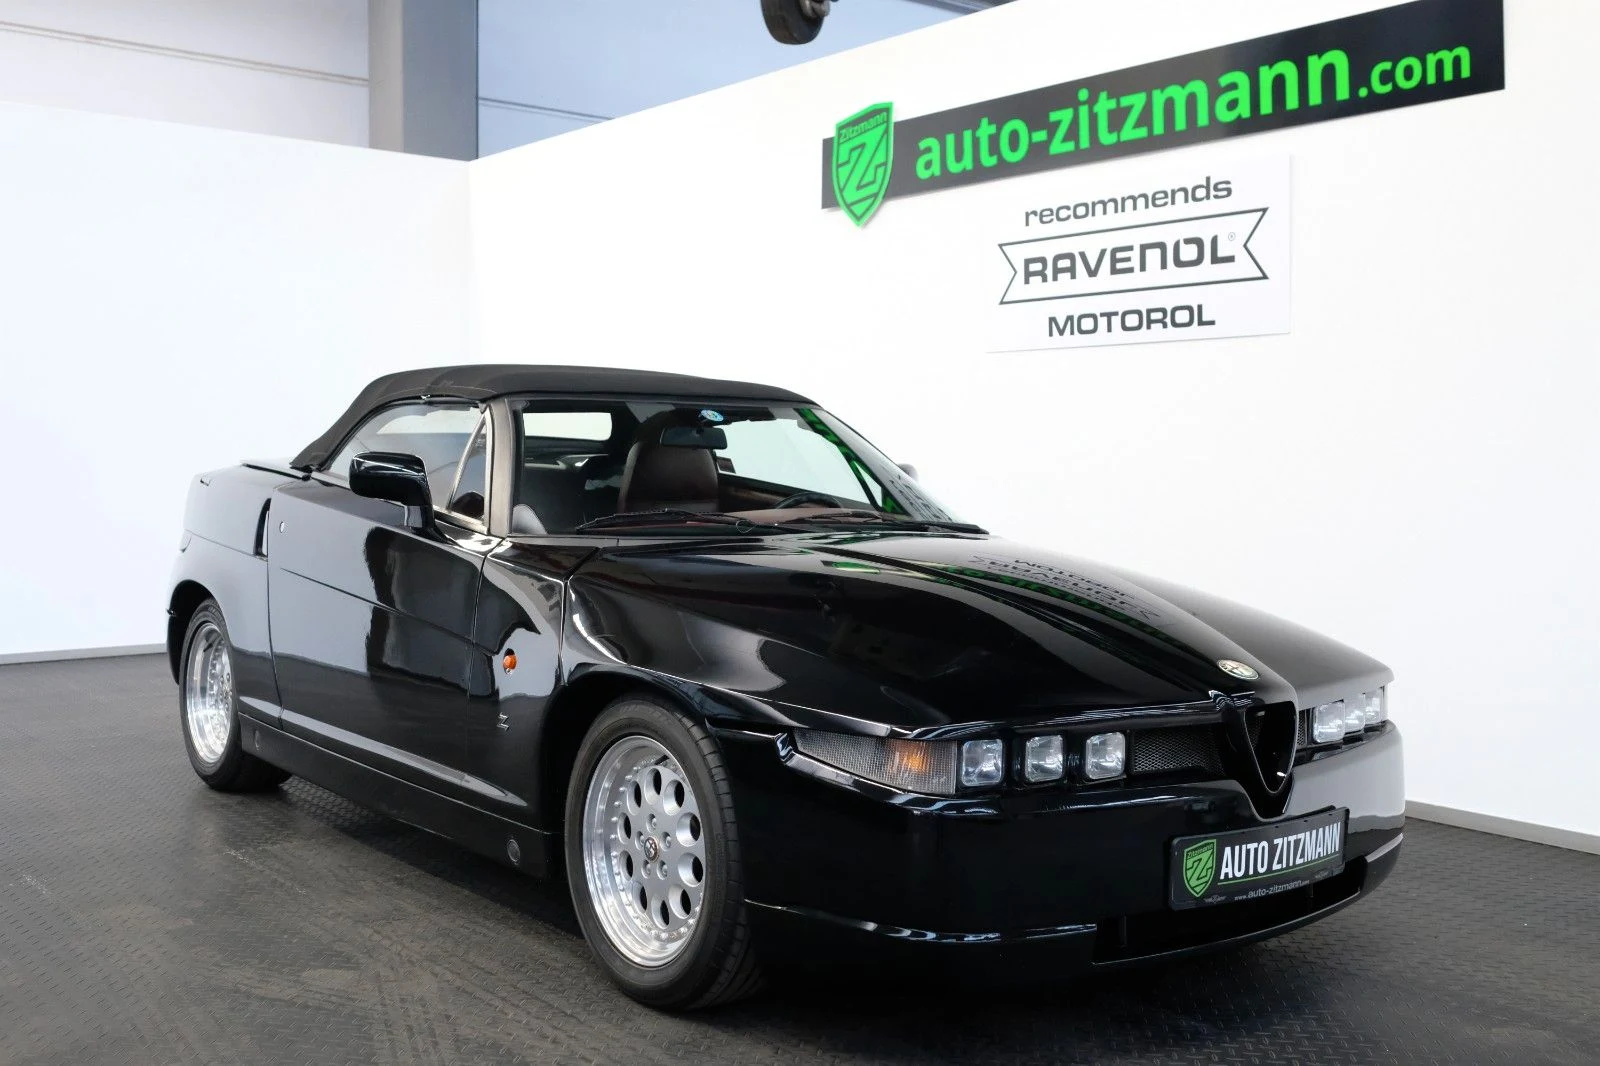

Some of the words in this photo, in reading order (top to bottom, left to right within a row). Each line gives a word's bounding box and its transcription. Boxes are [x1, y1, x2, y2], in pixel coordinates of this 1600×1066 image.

[916, 47, 1471, 180] auto-zitzmann.com
[1024, 176, 1233, 227] recommends
[1049, 304, 1216, 338] MOTOROL
[1220, 840, 1268, 880] AUTO
[1272, 822, 1341, 871] ZITZMANN
